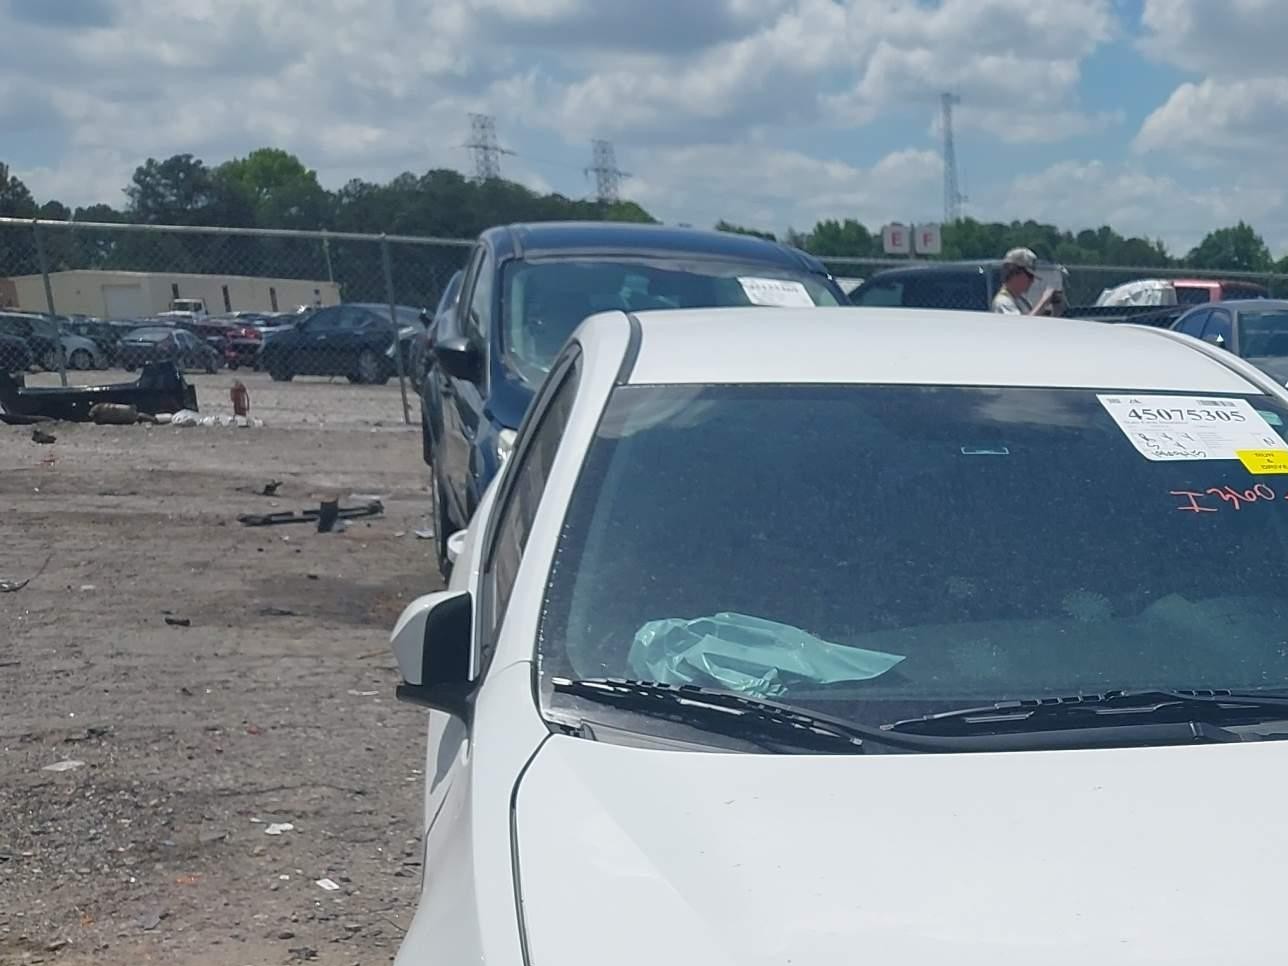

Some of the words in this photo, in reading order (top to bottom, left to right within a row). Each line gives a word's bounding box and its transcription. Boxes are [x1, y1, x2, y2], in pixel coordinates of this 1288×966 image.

[892, 231, 903, 247] E
[923, 231, 933, 247] F
[1128, 408, 1246, 423] 45075305
